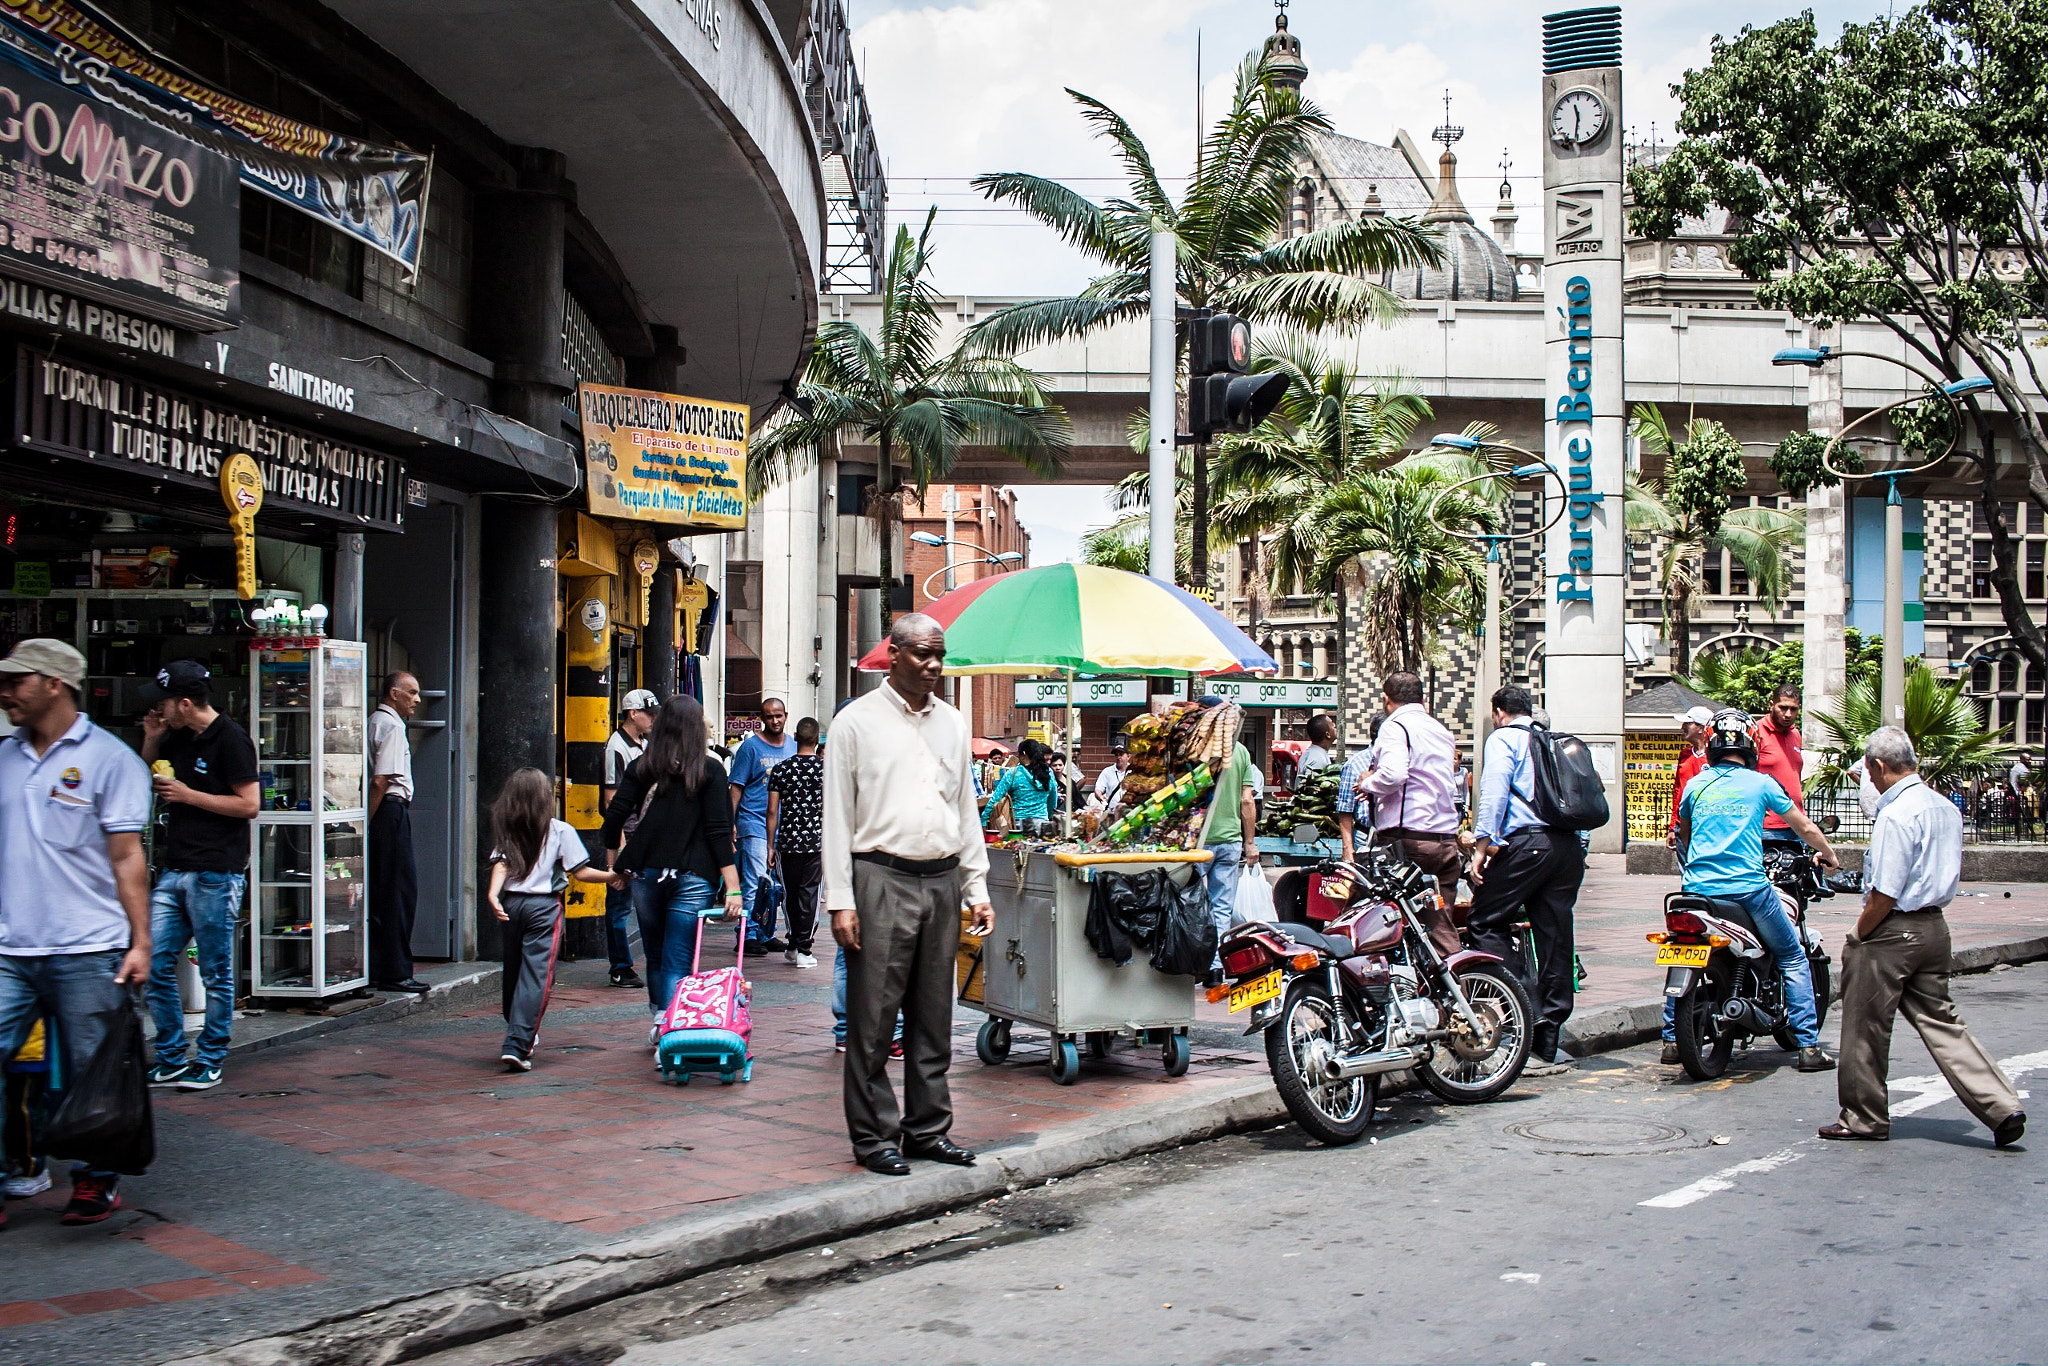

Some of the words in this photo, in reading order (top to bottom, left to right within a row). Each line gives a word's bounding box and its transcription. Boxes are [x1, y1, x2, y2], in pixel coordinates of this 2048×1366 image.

[1558, 242, 1599, 255] METRO
[66, 299, 81, 332] A
[85, 305, 175, 358] PRESION
[217, 341, 229, 374] Y
[268, 362, 354, 413] SANITARIOS
[583, 390, 672, 433] PARQUEADERO
[674, 402, 744, 442] MOTOPARKS
[632, 433, 643, 444] El
[646, 437, 682, 449] paraiso
[685, 440, 698, 452] de
[701, 443, 712, 453] tu
[676, 454, 687, 467] de
[689, 456, 729, 474] Bodegaje
[618, 482, 651, 513] Parqueo
[652, 484, 660, 508] de
[663, 487, 685, 511] Motos
[687, 496, 694, 518] y
[696, 489, 743, 516] Bicicletas
[1556, 437, 1604, 605] Parque
[1090, 683, 1123, 701] gana
[1260, 685, 1287, 702] gana
[1306, 686, 1332, 702] gana
[727, 719, 762, 732] rebaja
